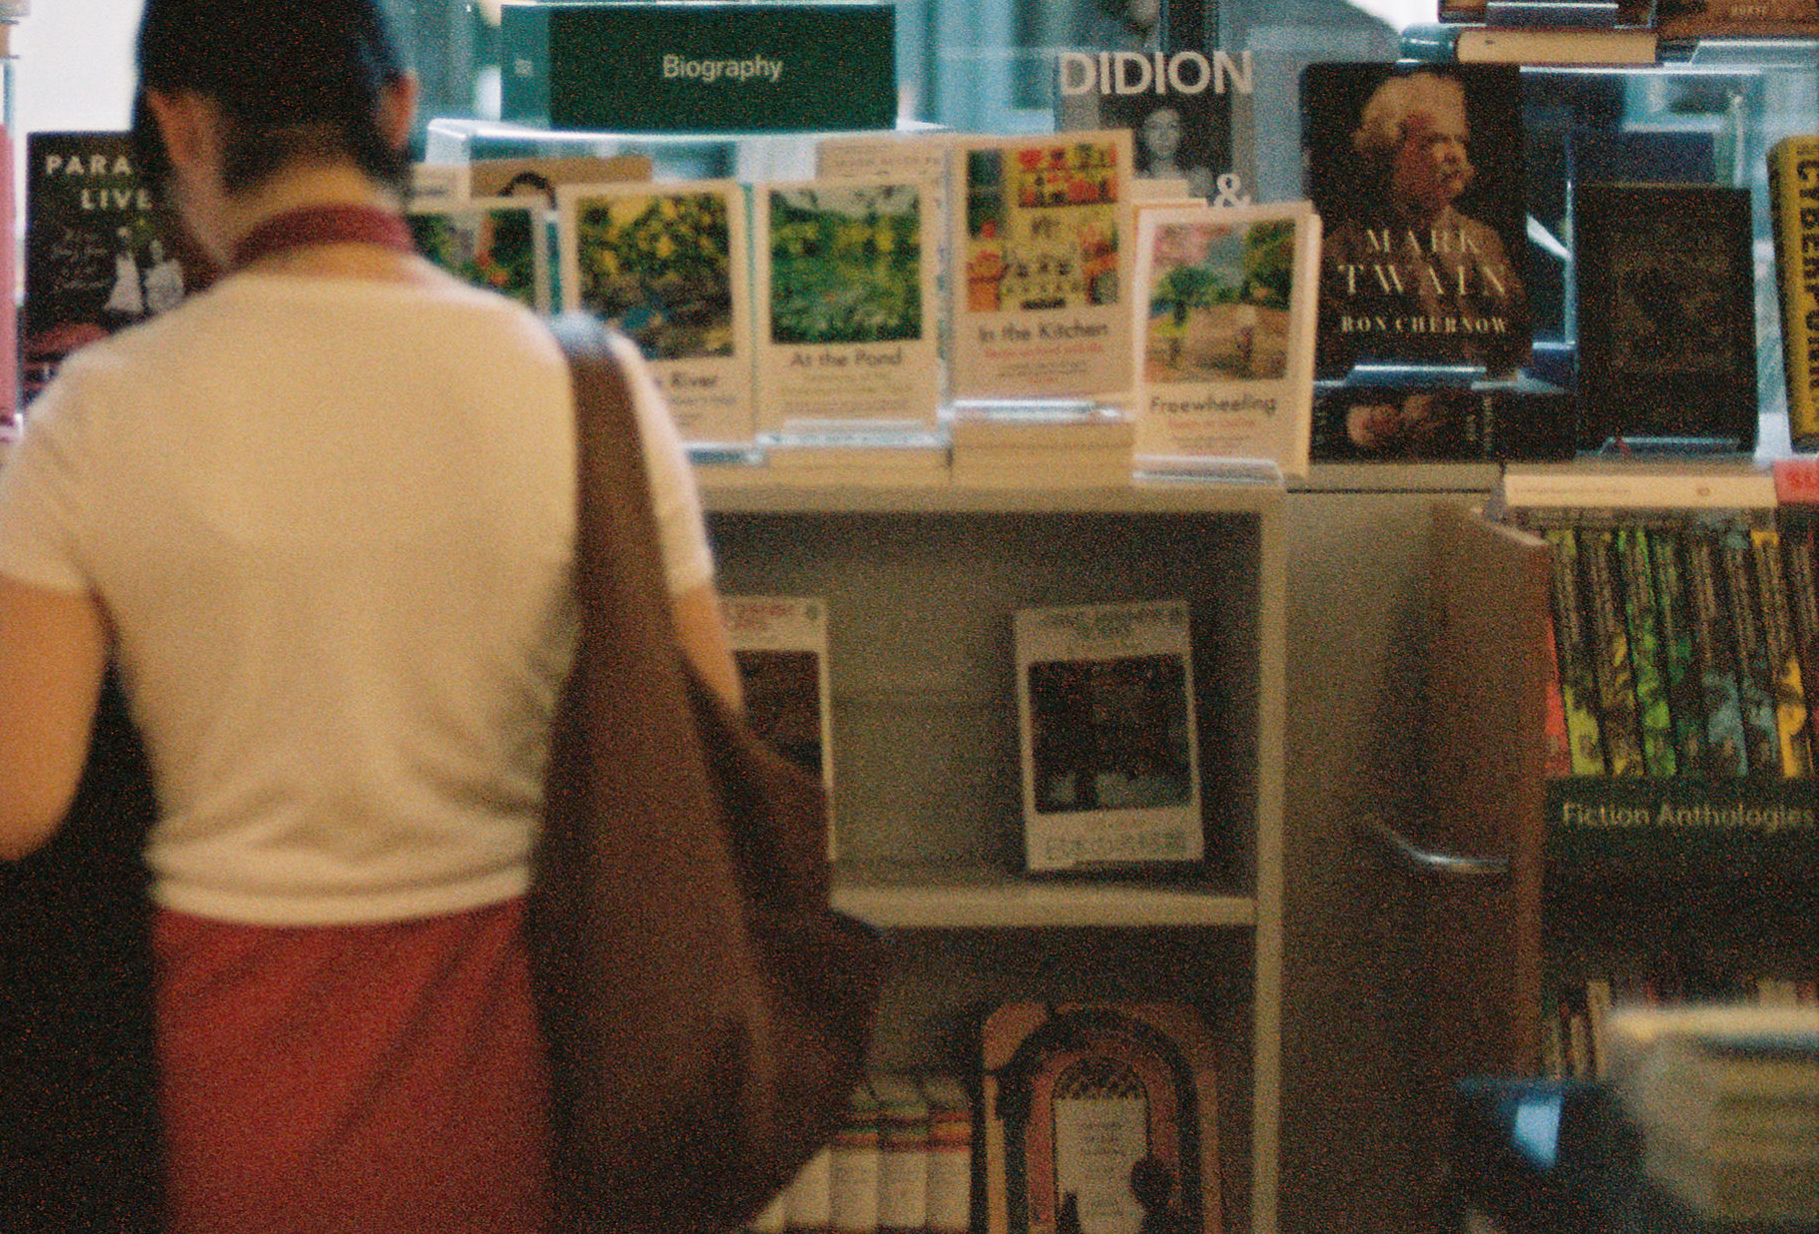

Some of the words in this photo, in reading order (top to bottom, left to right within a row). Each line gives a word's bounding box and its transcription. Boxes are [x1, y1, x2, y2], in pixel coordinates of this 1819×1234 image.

[662, 53, 784, 83] Biography
[1060, 50, 1253, 96] DIDION
[1366, 229, 1481, 254] MARK
[1337, 264, 1506, 296] TWAIN
[1001, 322, 1032, 341] the
[1037, 319, 1109, 340] Kitchen
[1340, 316, 1387, 333] RON
[1395, 316, 1506, 333] CHERNOW
[790, 352, 813, 367] At
[817, 350, 848, 367] the
[853, 346, 903, 366] Pond
[1150, 394, 1278, 416] Freewheeling
[1562, 802, 1650, 829] Fiction
[1657, 802, 1815, 835] Anthologies
